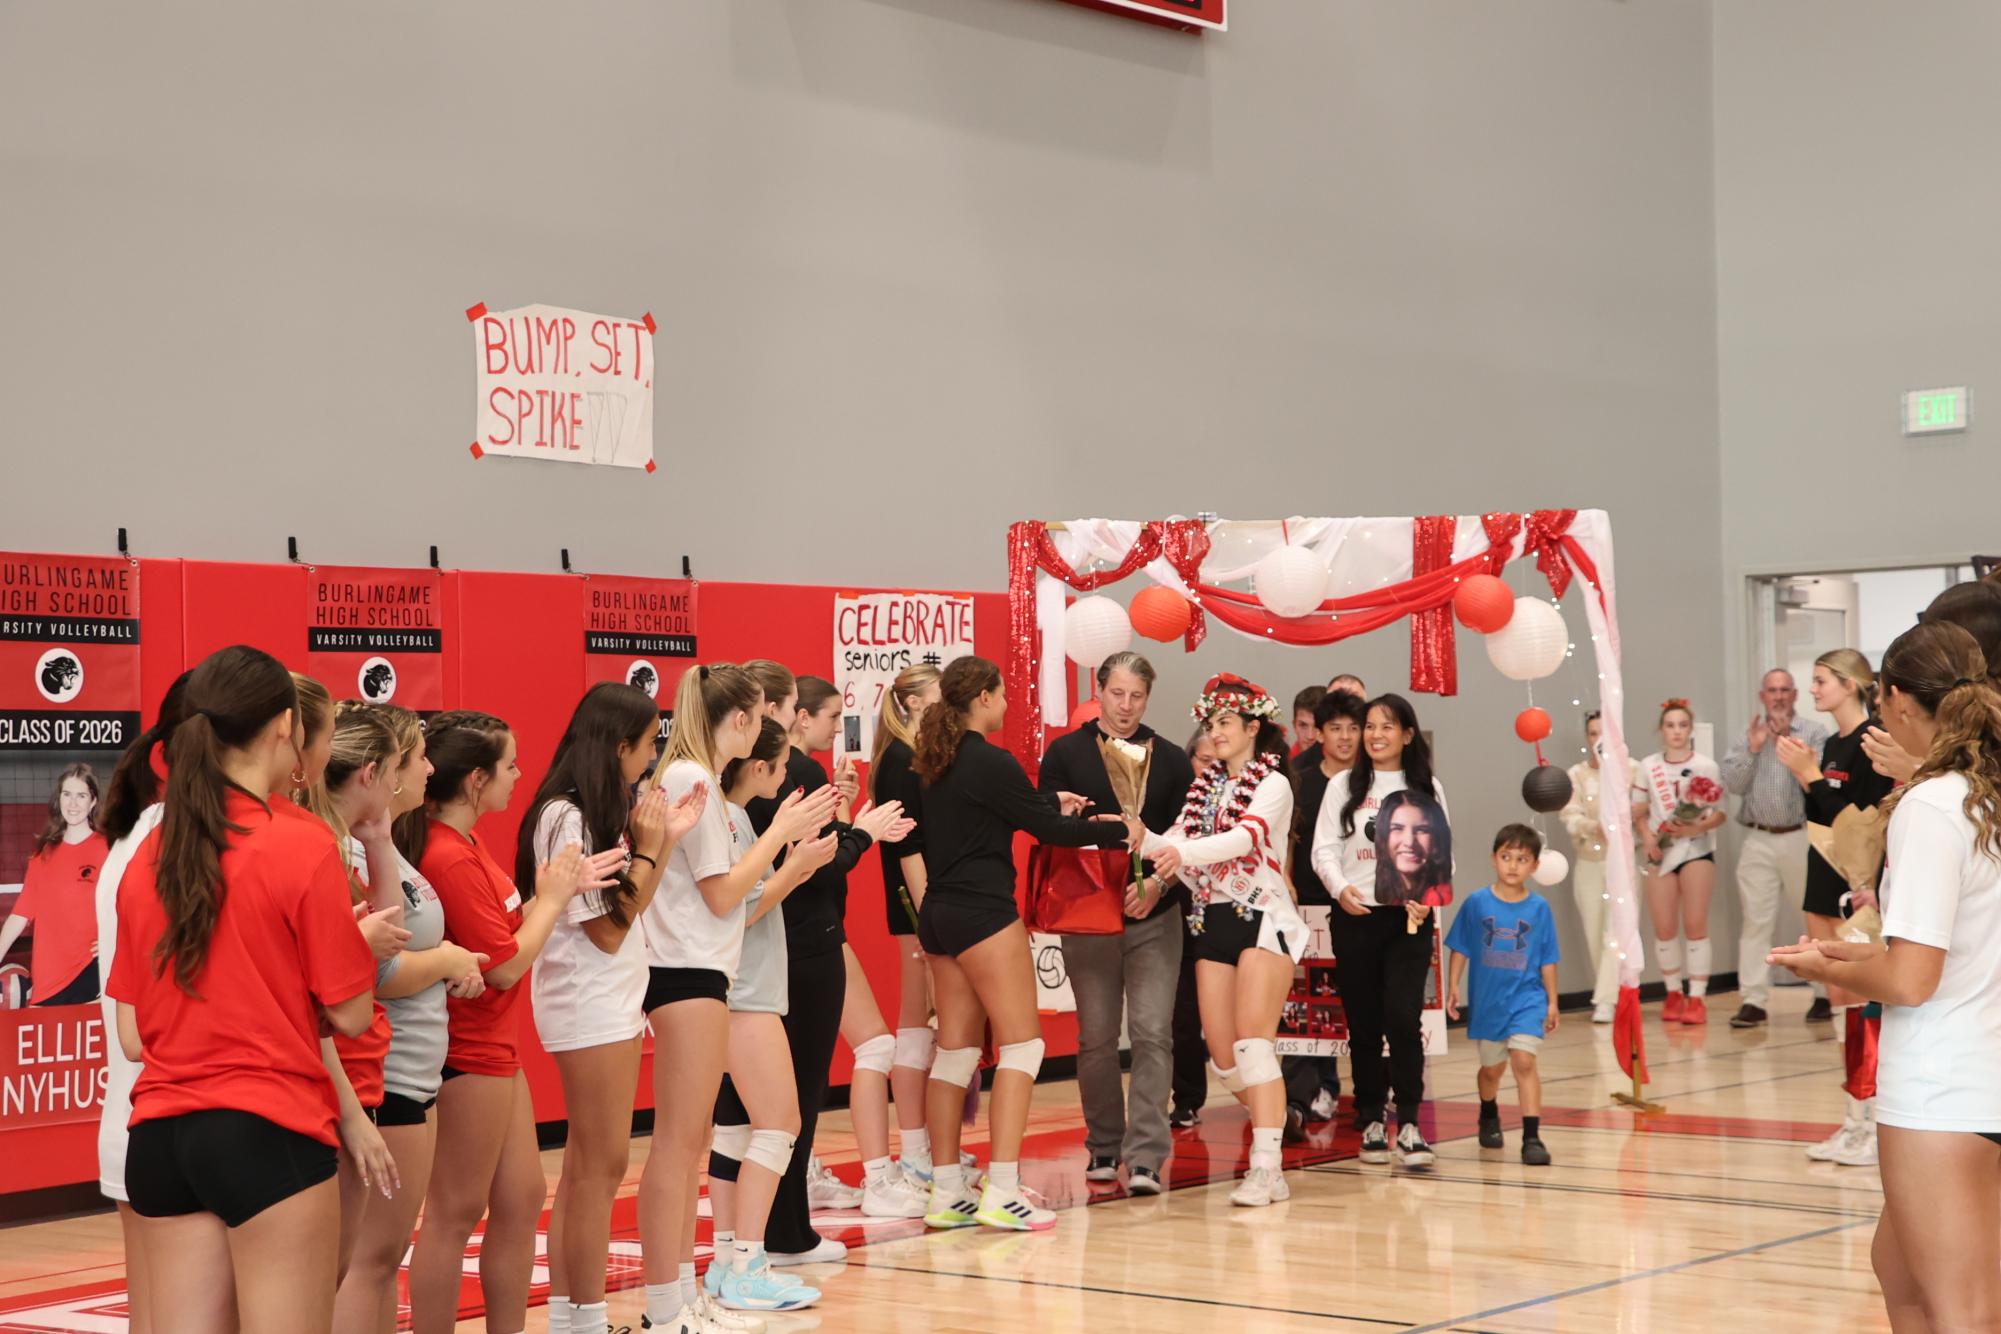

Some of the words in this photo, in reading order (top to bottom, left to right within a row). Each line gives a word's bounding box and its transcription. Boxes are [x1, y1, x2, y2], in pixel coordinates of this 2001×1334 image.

[1919, 394, 1958, 426] EXIT
[4, 563, 129, 591] URLINGAME
[1, 589, 37, 612] IGH
[49, 591, 131, 616] SCHOOL
[318, 583, 431, 605] BURLINGAME
[592, 590, 689, 613] BURLINGAME
[316, 605, 359, 626] HIGH
[367, 607, 433, 627] SCHOOL
[591, 612, 627, 631] HIGH
[635, 614, 691, 634] SCHOOL
[838, 600, 973, 647] CELEBRATE
[3, 621, 42, 635] RSITY
[50, 623, 132, 638] VOLLEYBALL
[316, 634, 363, 646] VARSITY
[368, 635, 434, 647] VOLLEYBALL
[591, 637, 630, 650] VARSITY
[636, 639, 691, 652] VOLLEYBALL
[844, 649, 911, 672] seniors
[0, 718, 51, 744] CLASS
[54, 720, 76, 744] OF
[79, 721, 122, 744] 2026
[1247, 886, 1263, 904] BHS
[18, 1019, 102, 1065] ELLIE
